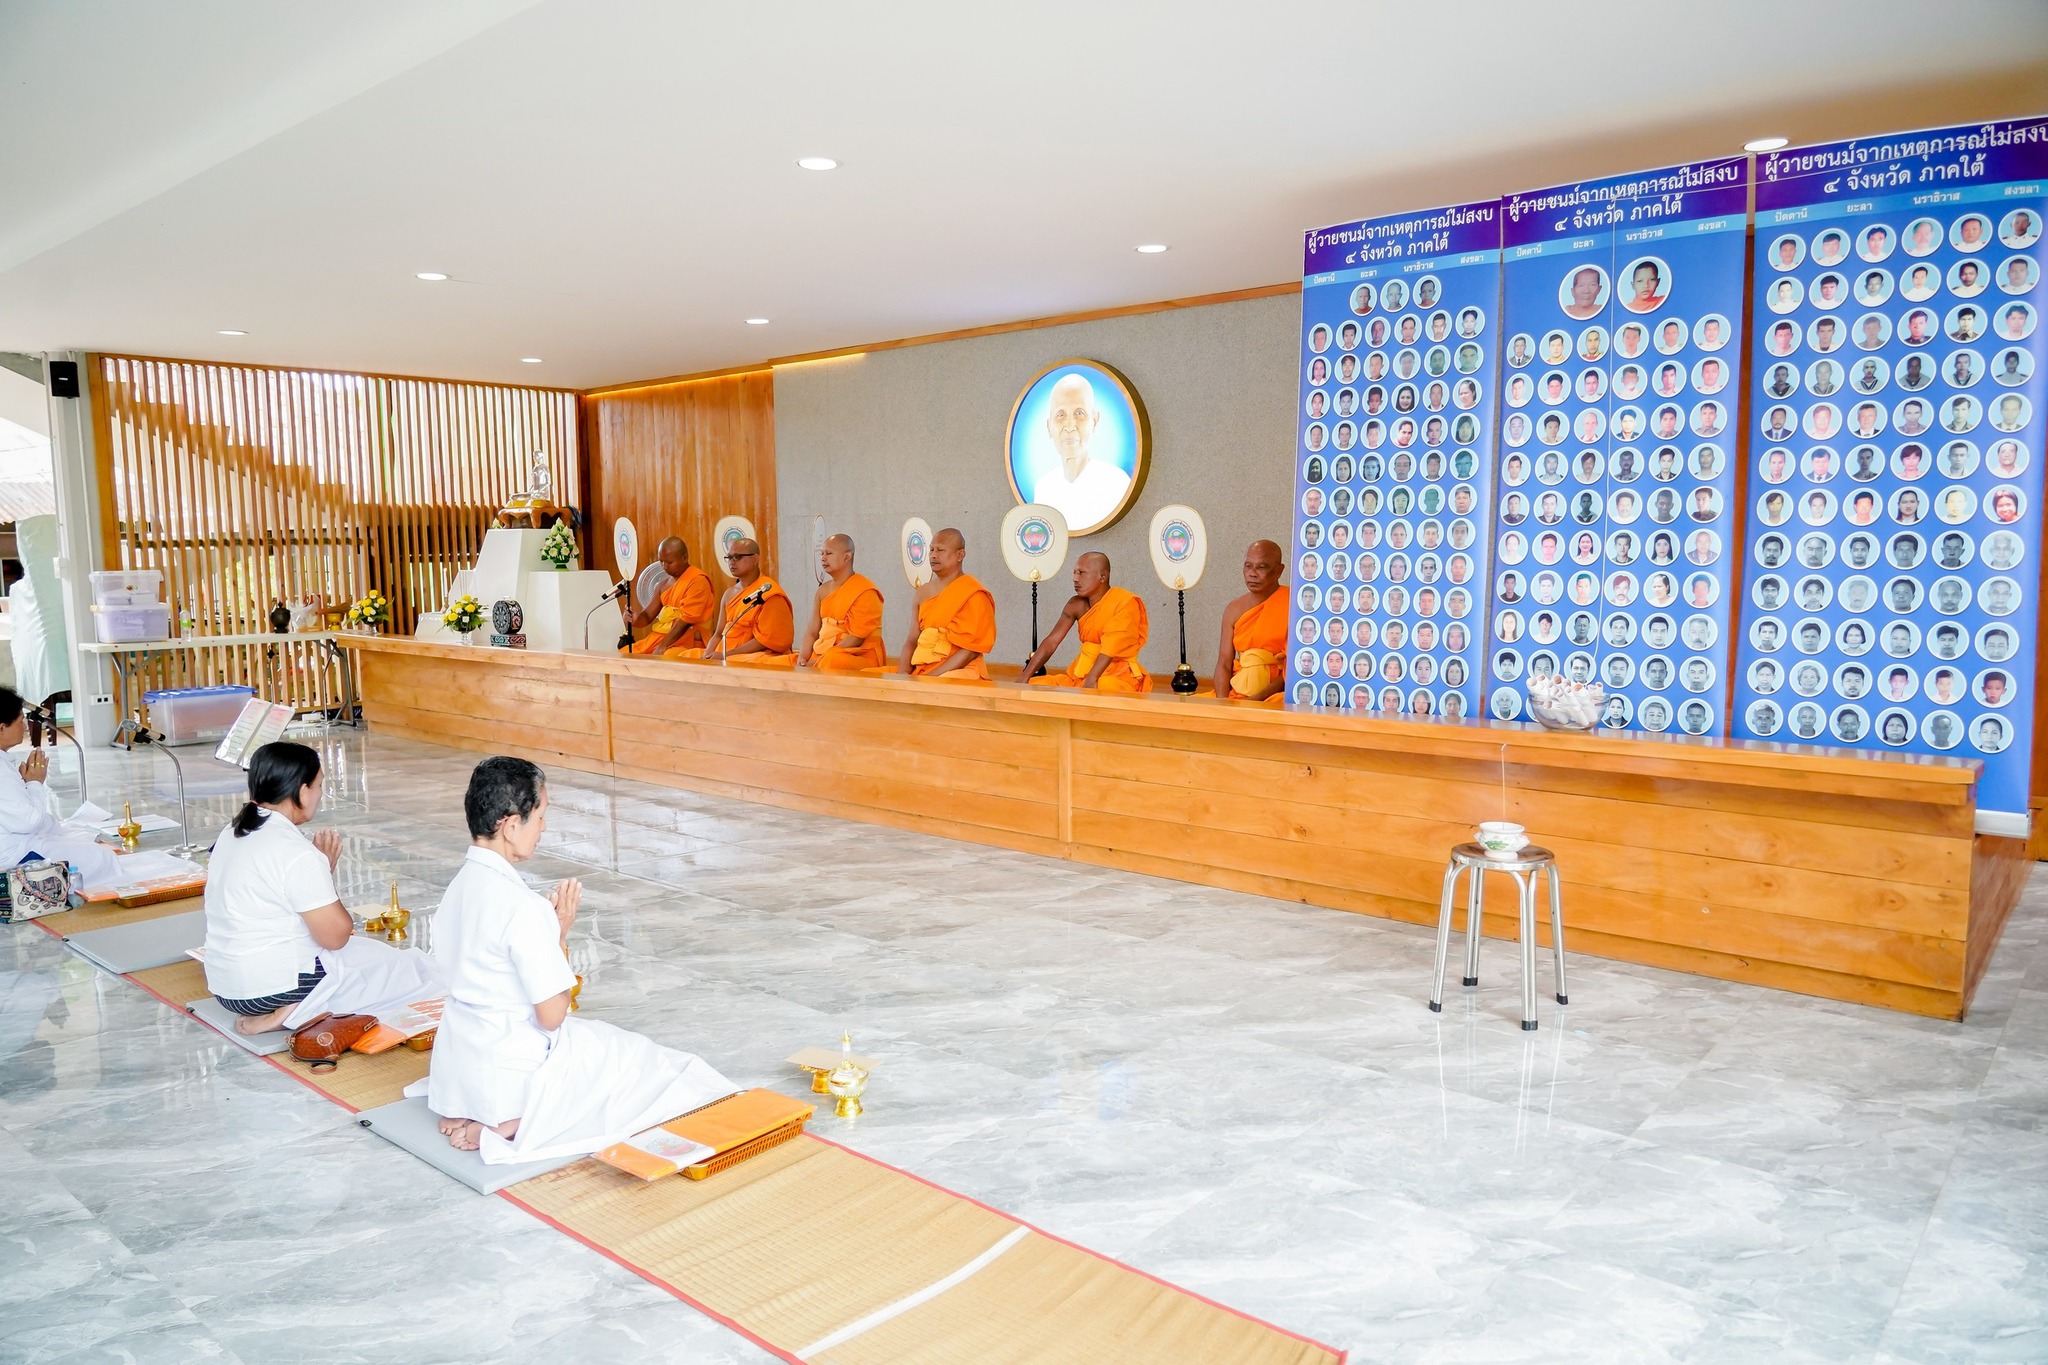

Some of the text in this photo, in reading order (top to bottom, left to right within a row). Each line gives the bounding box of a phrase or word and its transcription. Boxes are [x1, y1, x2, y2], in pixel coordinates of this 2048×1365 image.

[1508, 165, 1738, 223] ผู้วายชนม์จากเหตุการณ์ไม่สงบ
[1823, 153, 1987, 194] ๔ จังหวัด ภาคใต้
[1308, 207, 1494, 254] ผู้วายชนม์จากเหตุการณ์ไม่สงบ
[1554, 193, 1682, 232] ๔ จังหวัด ภาคใต้
[1345, 231, 1449, 265] ๔ จังหวัด ภาคใต้
